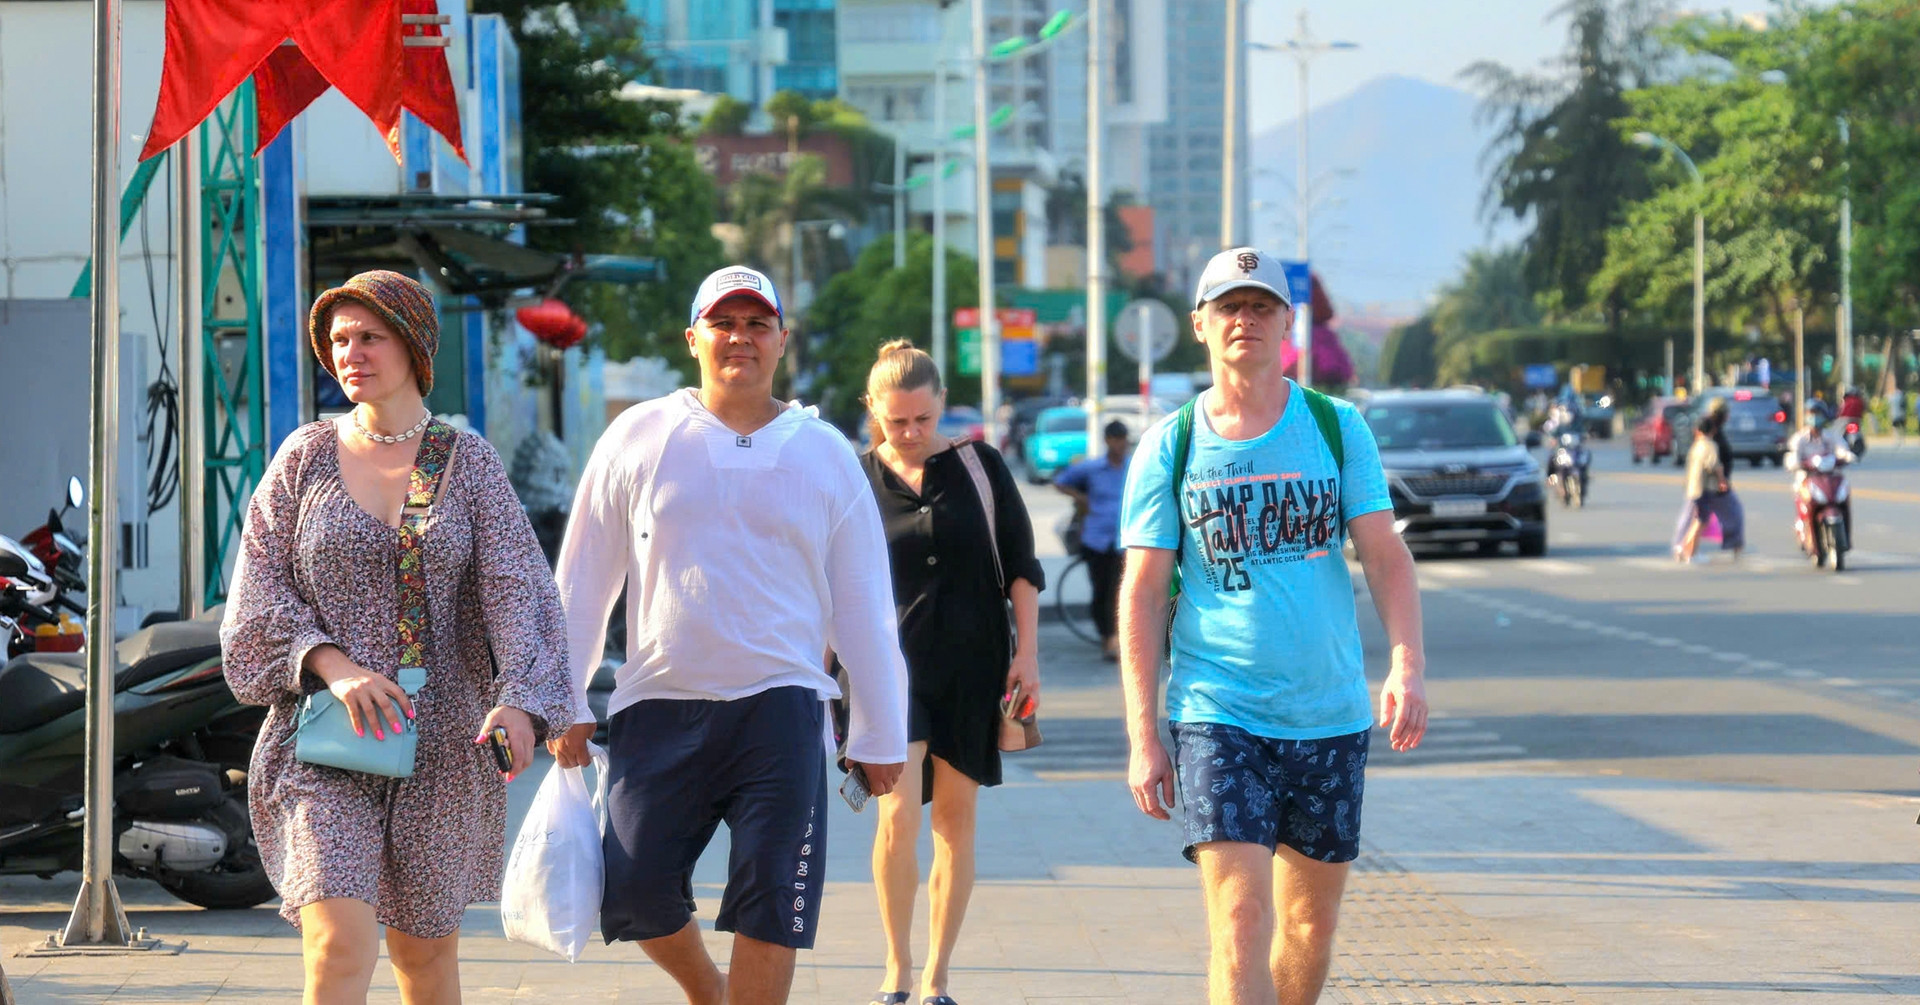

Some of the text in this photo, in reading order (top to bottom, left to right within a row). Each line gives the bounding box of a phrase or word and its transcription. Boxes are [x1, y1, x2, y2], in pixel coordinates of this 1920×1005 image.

[1207, 466, 1224, 479] the
[1223, 459, 1255, 478] Thrill
[1280, 471, 1303, 481] SPOT
[1186, 478, 1337, 520] CAMP DAVID
[1189, 502, 1255, 564] Tall
[1245, 550, 1257, 558] BIG
[1250, 557, 1284, 566] ATLANTIC
[1284, 554, 1305, 563] OCEAN
[1217, 556, 1252, 592] 25
